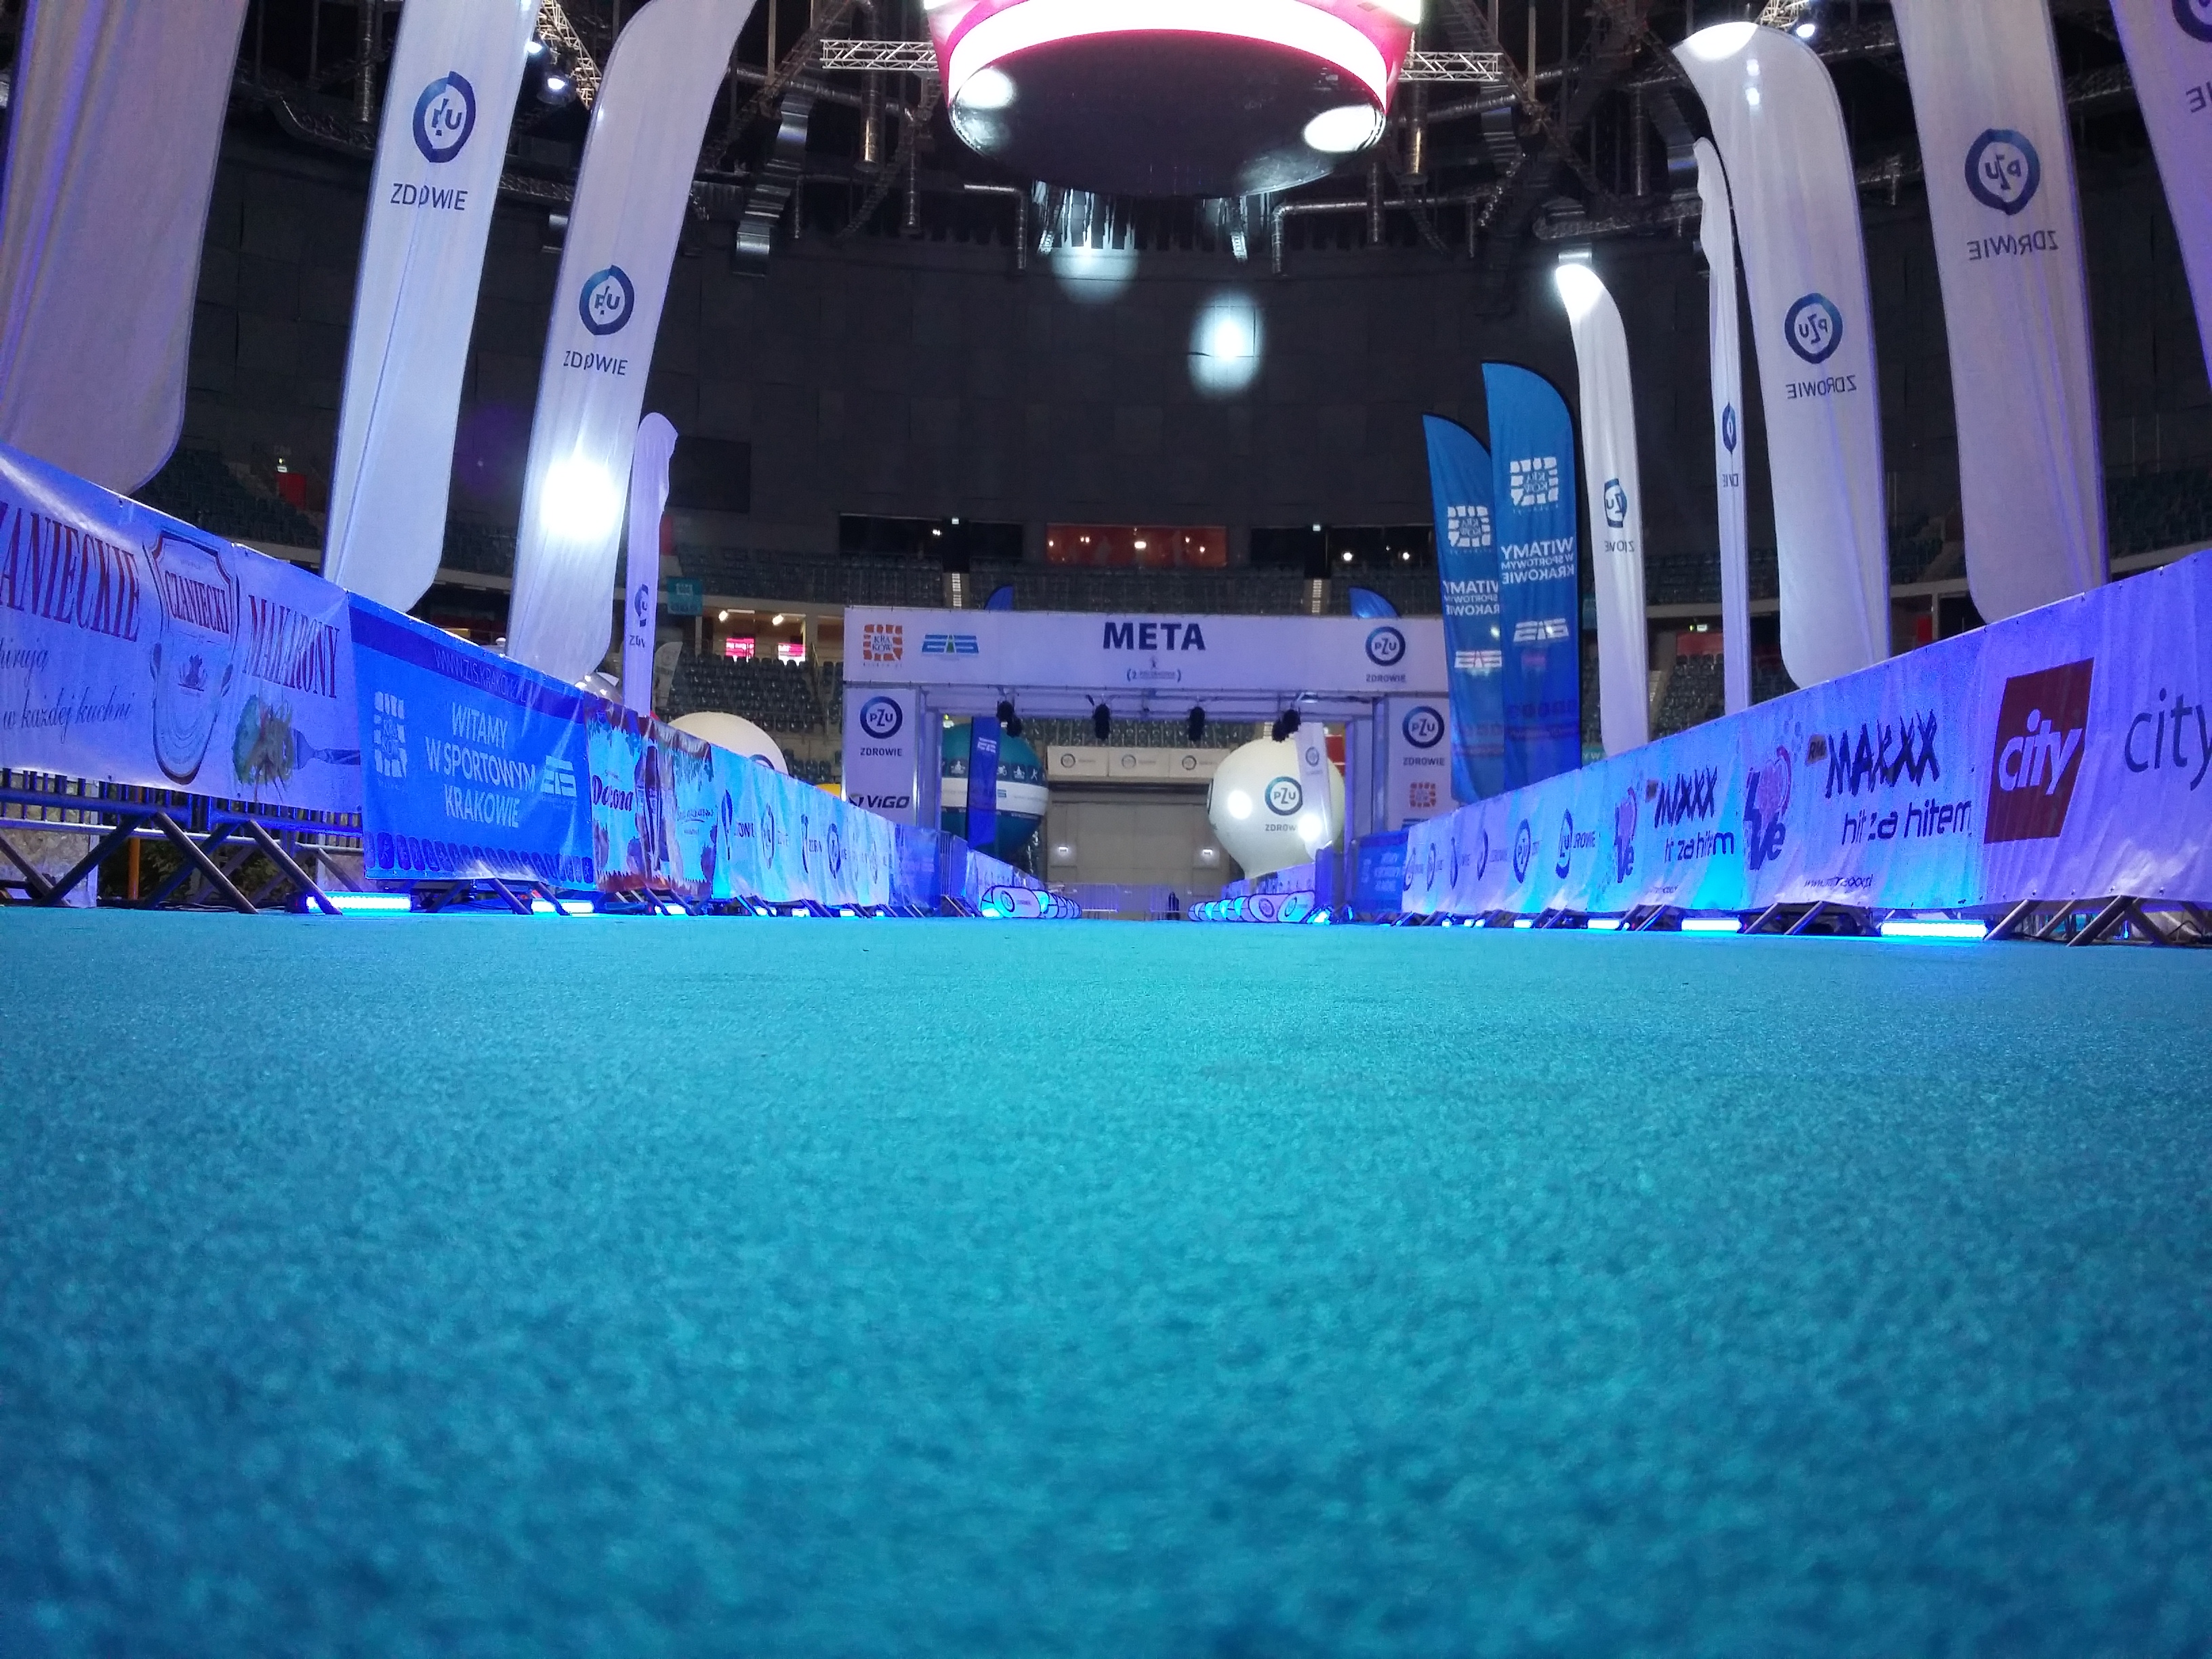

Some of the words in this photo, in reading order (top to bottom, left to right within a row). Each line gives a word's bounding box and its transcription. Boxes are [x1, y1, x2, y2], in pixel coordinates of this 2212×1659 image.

[0, 501, 140, 642] ANIECKIE
[1103, 621, 1206, 651] META
[1374, 638, 1397, 655] PZU
[1366, 674, 1406, 683] ZDROWIE
[452, 701, 508, 750] WITAMY
[869, 708, 894, 727] PZU
[1412, 718, 1435, 737] PZU
[859, 747, 903, 757] ZDROWIE
[1403, 756, 1445, 766] ZDROWIE
[1999, 708, 2083, 795] city
[425, 735, 441, 773] W
[443, 741, 537, 793] SPORTOWYM
[1273, 787, 1296, 804] PZU
[443, 783, 520, 828] KRAKOWIE
[1265, 823, 1298, 832] ZDROW
[1903, 798, 1972, 838] hitem
